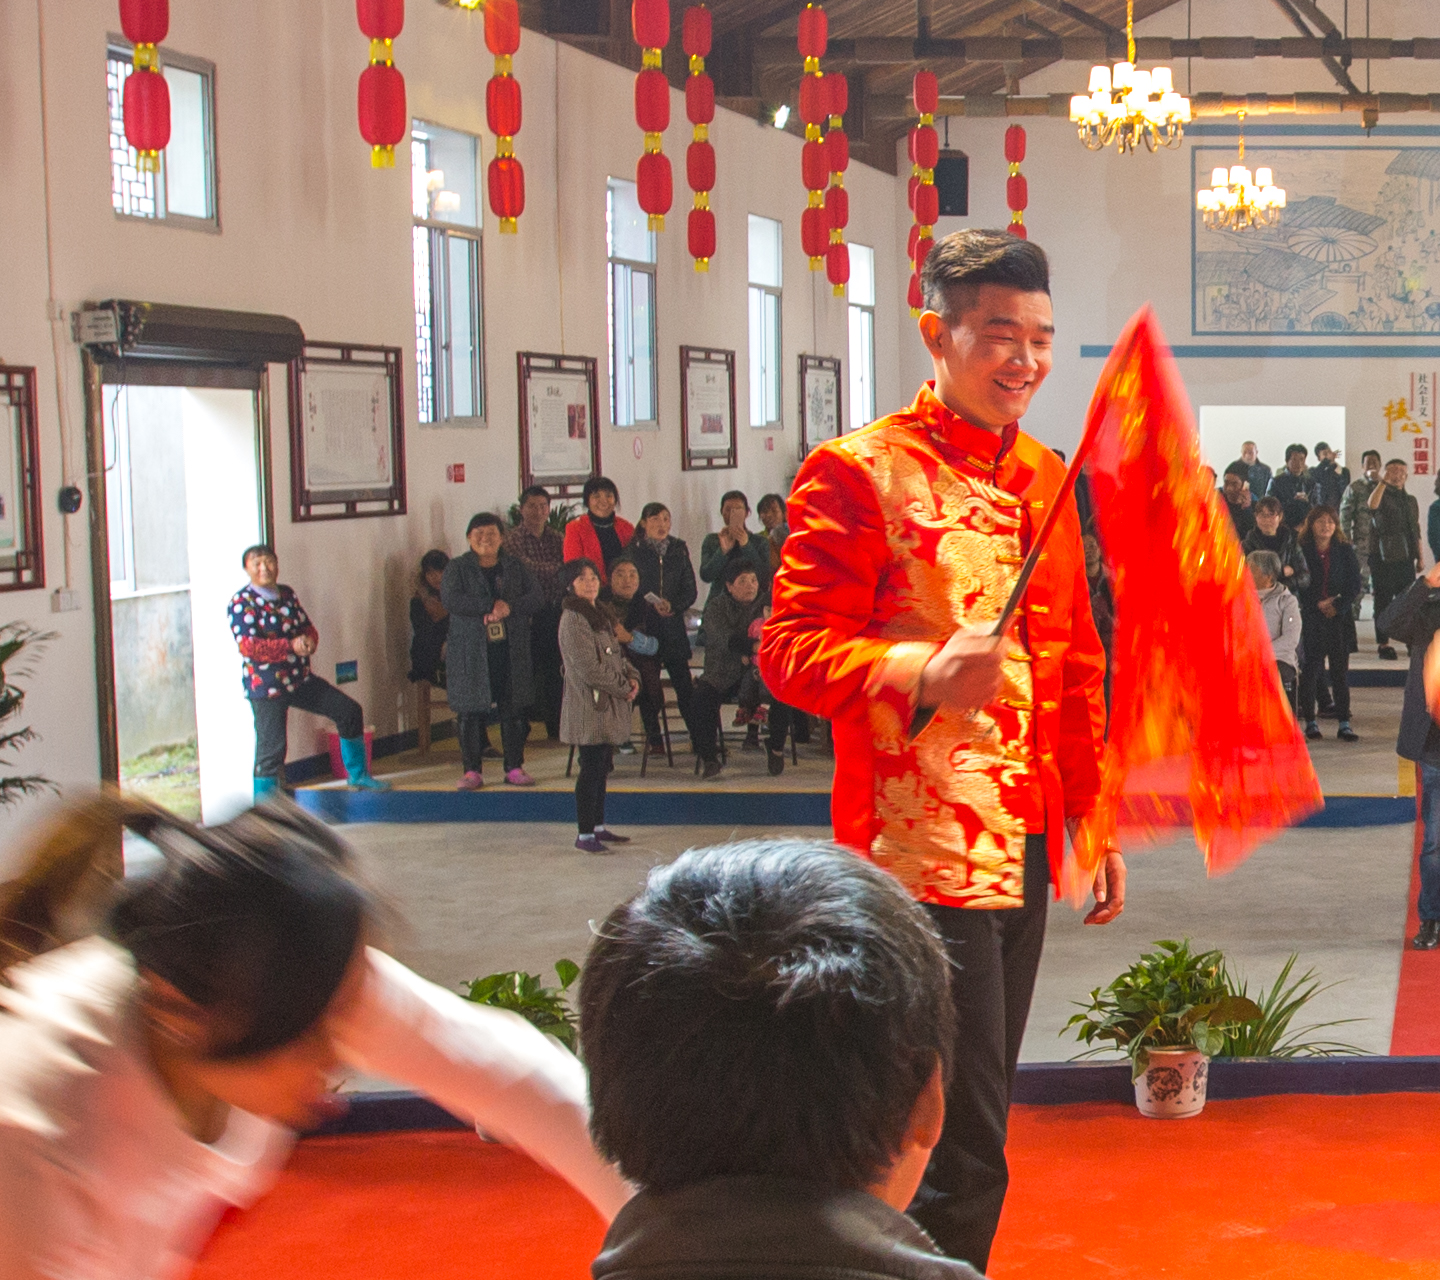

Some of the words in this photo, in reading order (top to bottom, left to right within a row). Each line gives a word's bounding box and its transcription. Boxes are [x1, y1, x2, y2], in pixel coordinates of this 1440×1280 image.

[1419, 373, 1428, 417] 社会主义
[1413, 436, 1429, 475] 价值观
